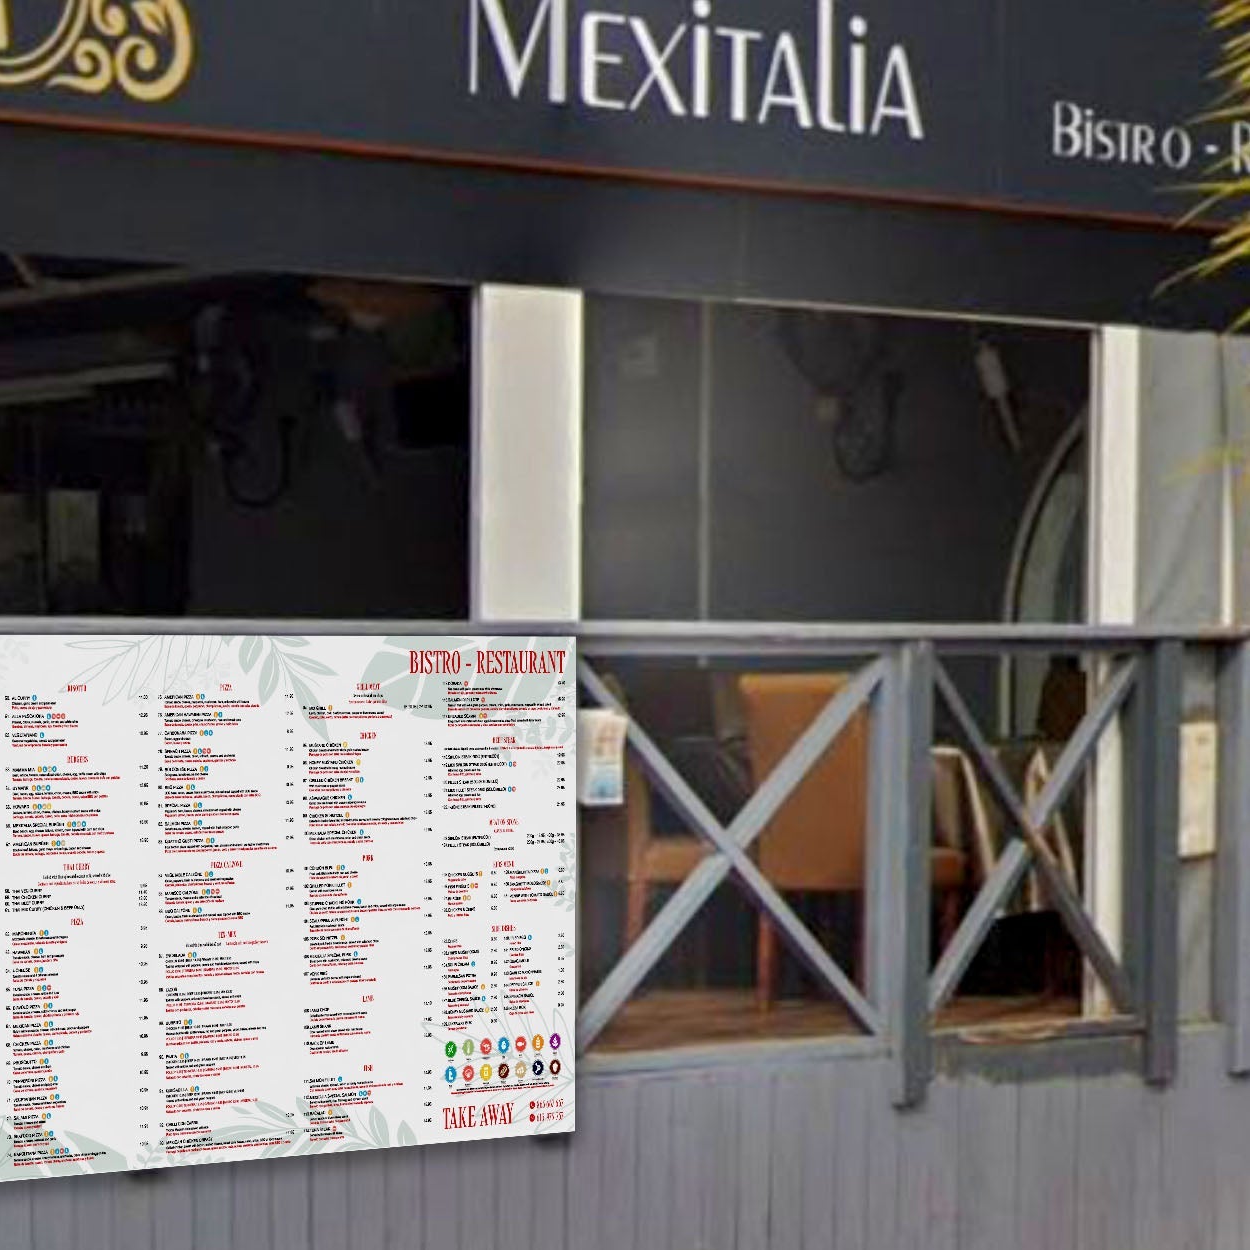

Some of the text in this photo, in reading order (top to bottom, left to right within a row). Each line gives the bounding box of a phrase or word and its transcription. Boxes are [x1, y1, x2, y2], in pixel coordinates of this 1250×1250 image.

[409, 650, 461, 675] BISTRO
[476, 650, 566, 675] RESTAURANT
[442, 1106, 476, 1130] TAKE
[480, 1102, 514, 1127] AWAY
